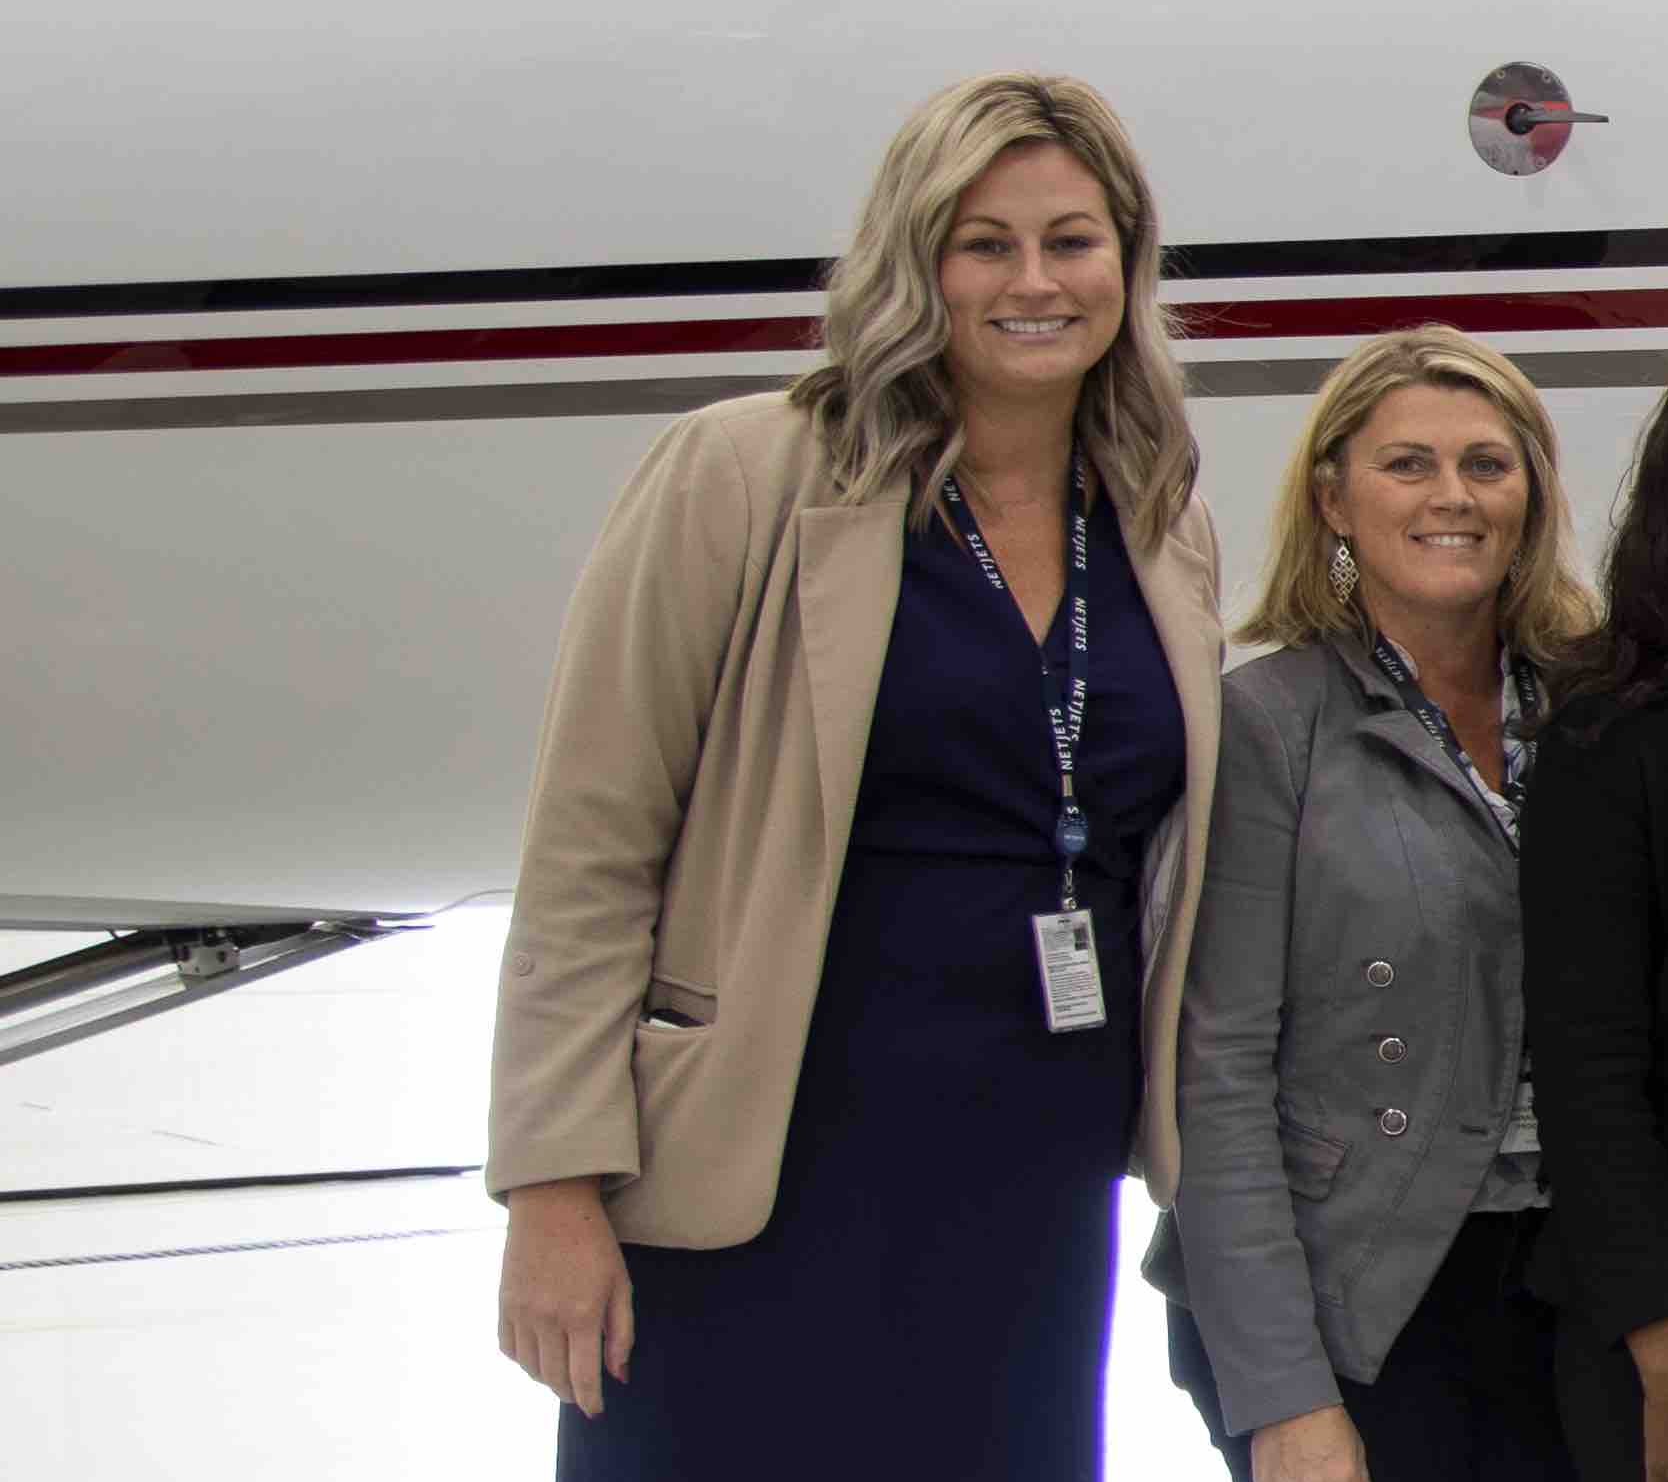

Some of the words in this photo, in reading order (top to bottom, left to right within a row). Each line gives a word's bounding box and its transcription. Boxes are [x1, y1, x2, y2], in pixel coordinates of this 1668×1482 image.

[968, 533, 1005, 590] NETJETS
[1071, 515, 1087, 571] NETJETS
[1071, 596, 1088, 652] NETJETS
[1050, 707, 1074, 771] NETJETS
